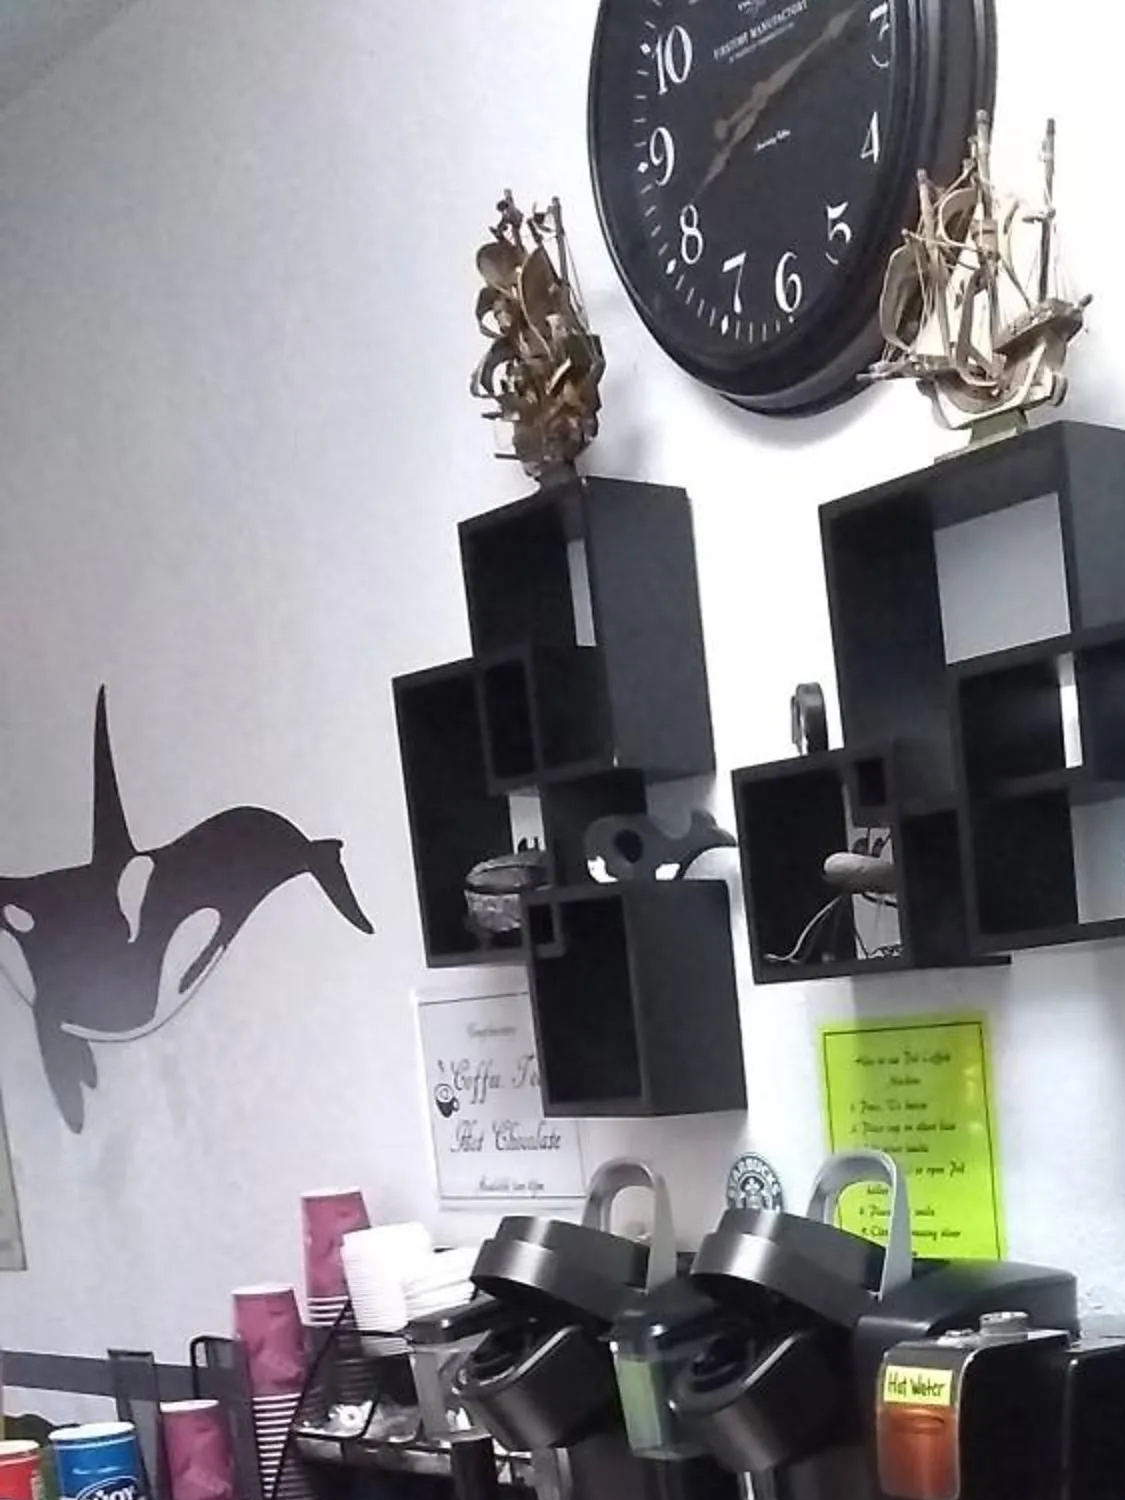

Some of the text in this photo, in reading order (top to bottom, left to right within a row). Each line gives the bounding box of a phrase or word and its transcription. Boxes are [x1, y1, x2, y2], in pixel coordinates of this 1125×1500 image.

[653, 26, 693, 95] 10
[649, 127, 675, 186] 9
[860, 111, 880, 163] 4
[679, 204, 703, 264] 8
[826, 202, 852, 265] 5
[722, 252, 747, 314] 7
[775, 252, 802, 313] 6
[887, 1371, 946, 1399] Hot Water
